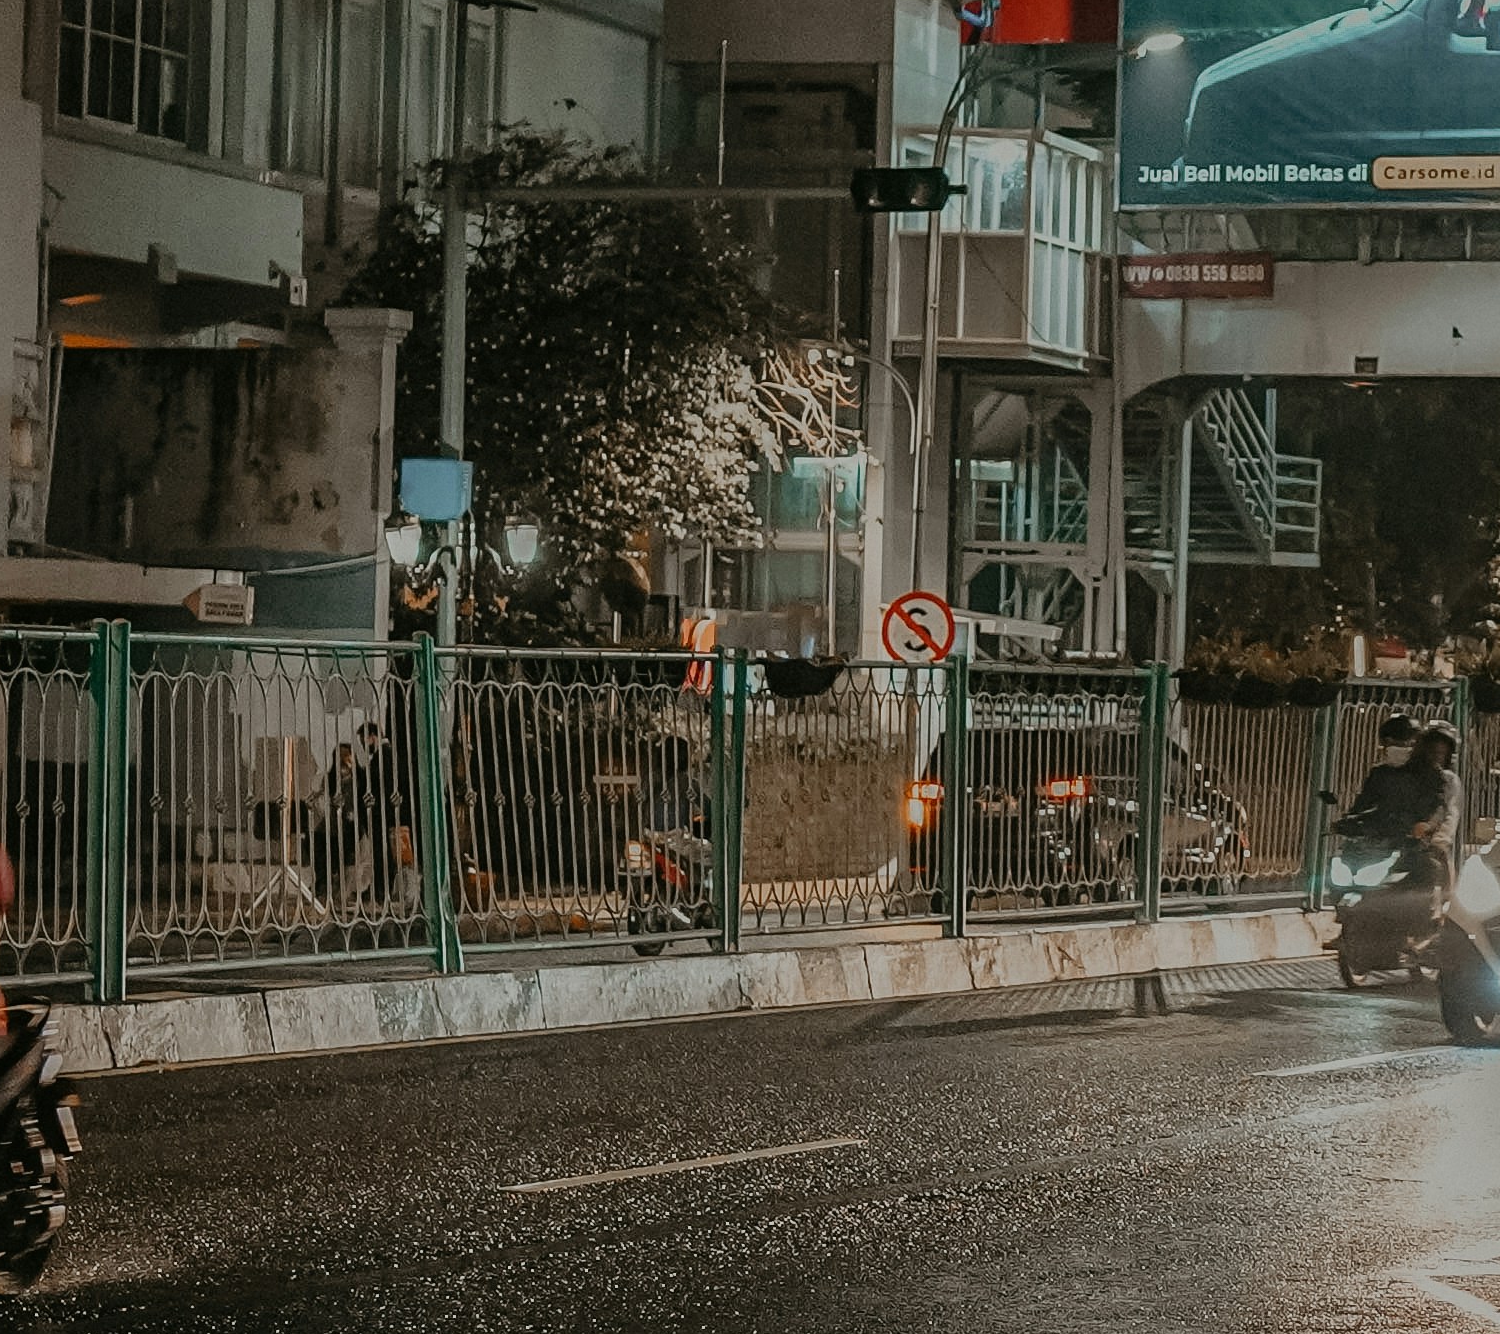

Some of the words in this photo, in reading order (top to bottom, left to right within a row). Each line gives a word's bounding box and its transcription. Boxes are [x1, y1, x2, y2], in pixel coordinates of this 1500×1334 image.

[1138, 165, 1179, 184] Jual
[1183, 163, 1221, 183] Beli
[1225, 163, 1280, 183] Mobil
[1283, 163, 1345, 183] Bekas
[1347, 163, 1369, 183] di
[1383, 164, 1496, 180] Carsome.id
